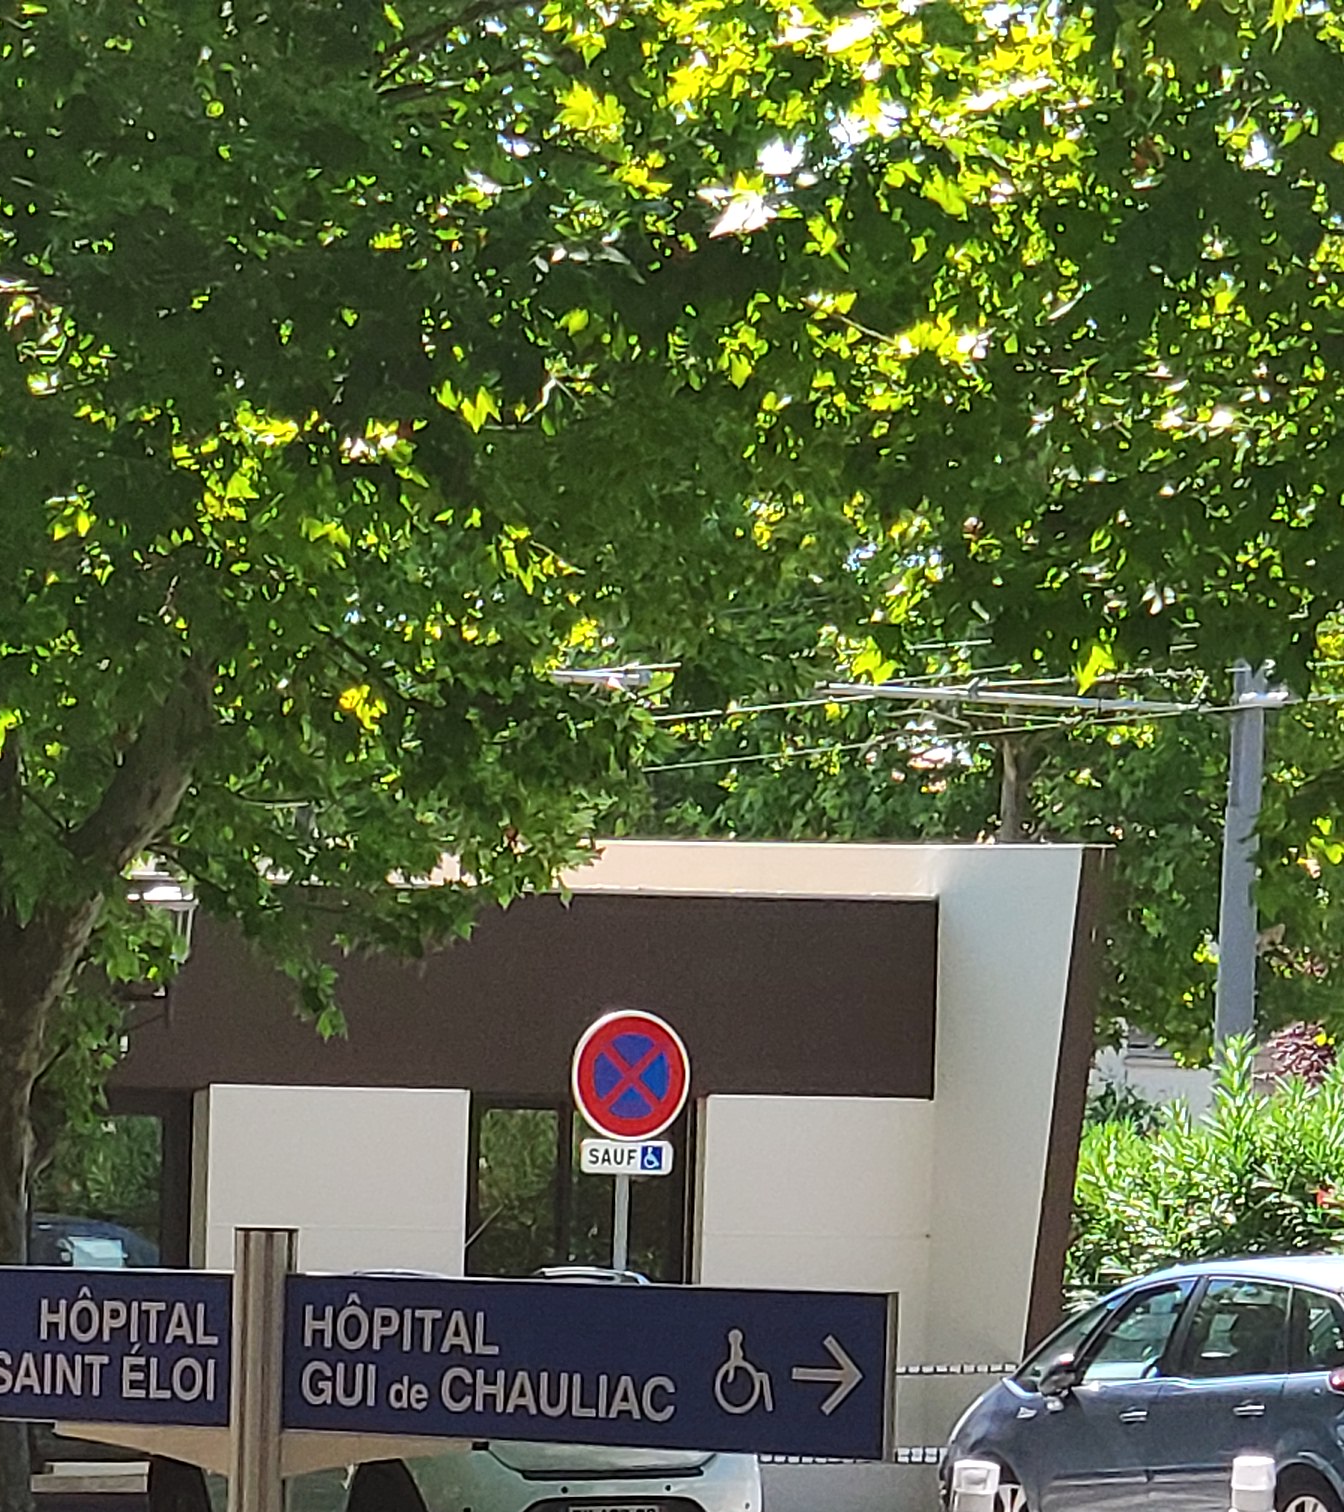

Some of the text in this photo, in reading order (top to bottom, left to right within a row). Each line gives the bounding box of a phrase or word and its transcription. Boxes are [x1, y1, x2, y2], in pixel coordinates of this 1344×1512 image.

[588, 1148, 637, 1166] SAUF
[40, 1286, 219, 1346] HÔPITAL
[303, 1293, 499, 1356] HÔPITAL
[122, 1343, 216, 1401] ÉLOI
[301, 1361, 675, 1423] GUI de CHAULIAC
